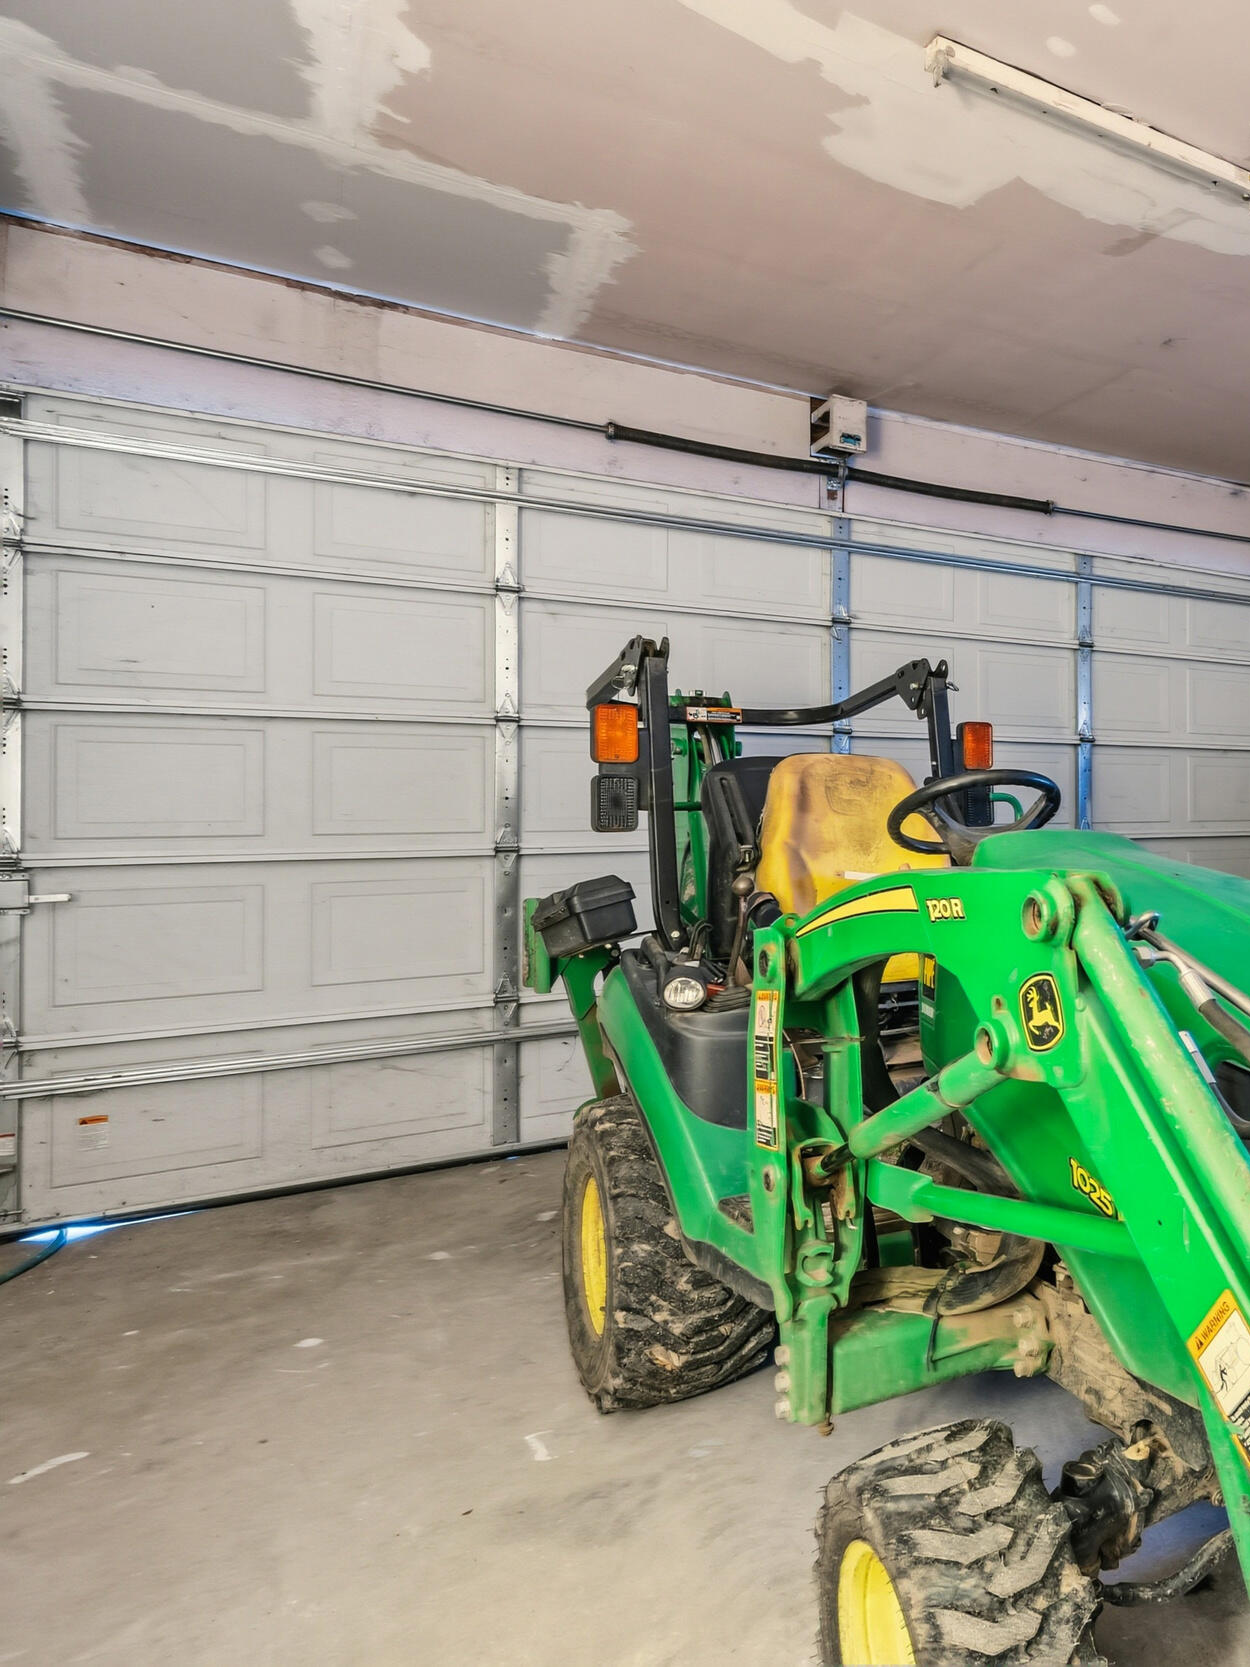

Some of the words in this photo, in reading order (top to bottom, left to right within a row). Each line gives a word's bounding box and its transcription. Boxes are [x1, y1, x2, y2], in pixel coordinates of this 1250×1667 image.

[925, 897, 965, 922] 120R
[1069, 1156, 1124, 1221] 1025
[1201, 1301, 1230, 1341] WARNING
